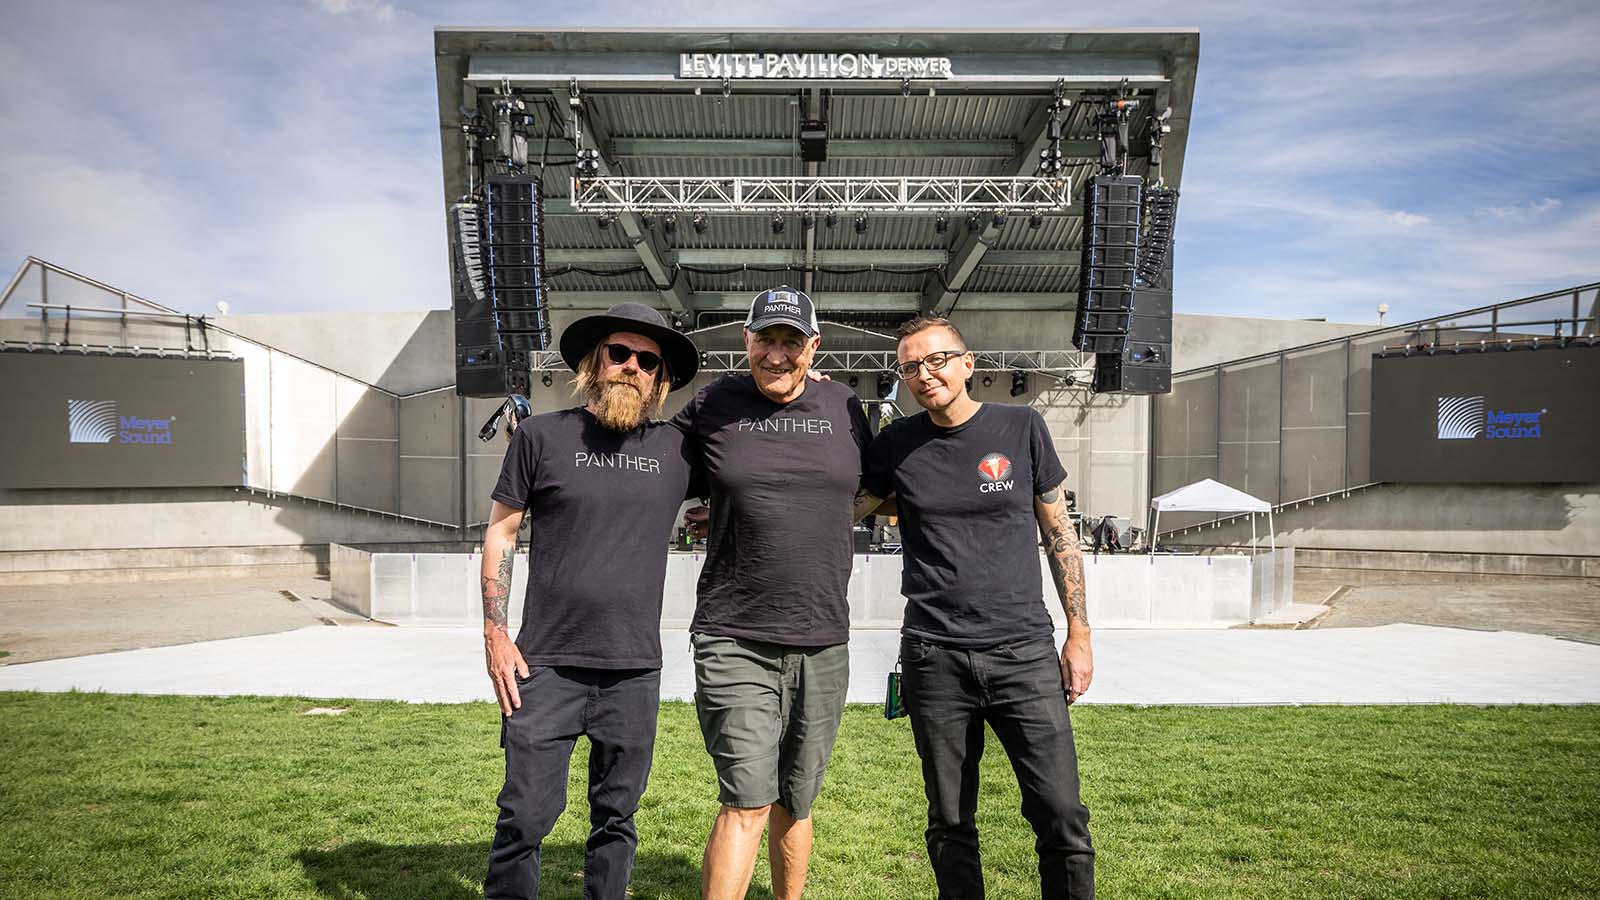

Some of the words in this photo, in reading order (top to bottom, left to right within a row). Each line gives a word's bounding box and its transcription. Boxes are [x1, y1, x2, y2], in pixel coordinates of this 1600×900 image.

[681, 53, 758, 75] LEVITT
[766, 53, 879, 75] PAVILION
[885, 57, 951, 74] DENVER
[764, 303, 801, 315] PANTHER
[119, 415, 169, 431] Meyer
[1487, 410, 1541, 425] Meyer
[738, 418, 833, 435] PANTHER
[1487, 425, 1541, 439] Sound
[119, 431, 171, 444] Sound
[575, 452, 660, 474] PANTHER
[980, 480, 1014, 493] CREW
